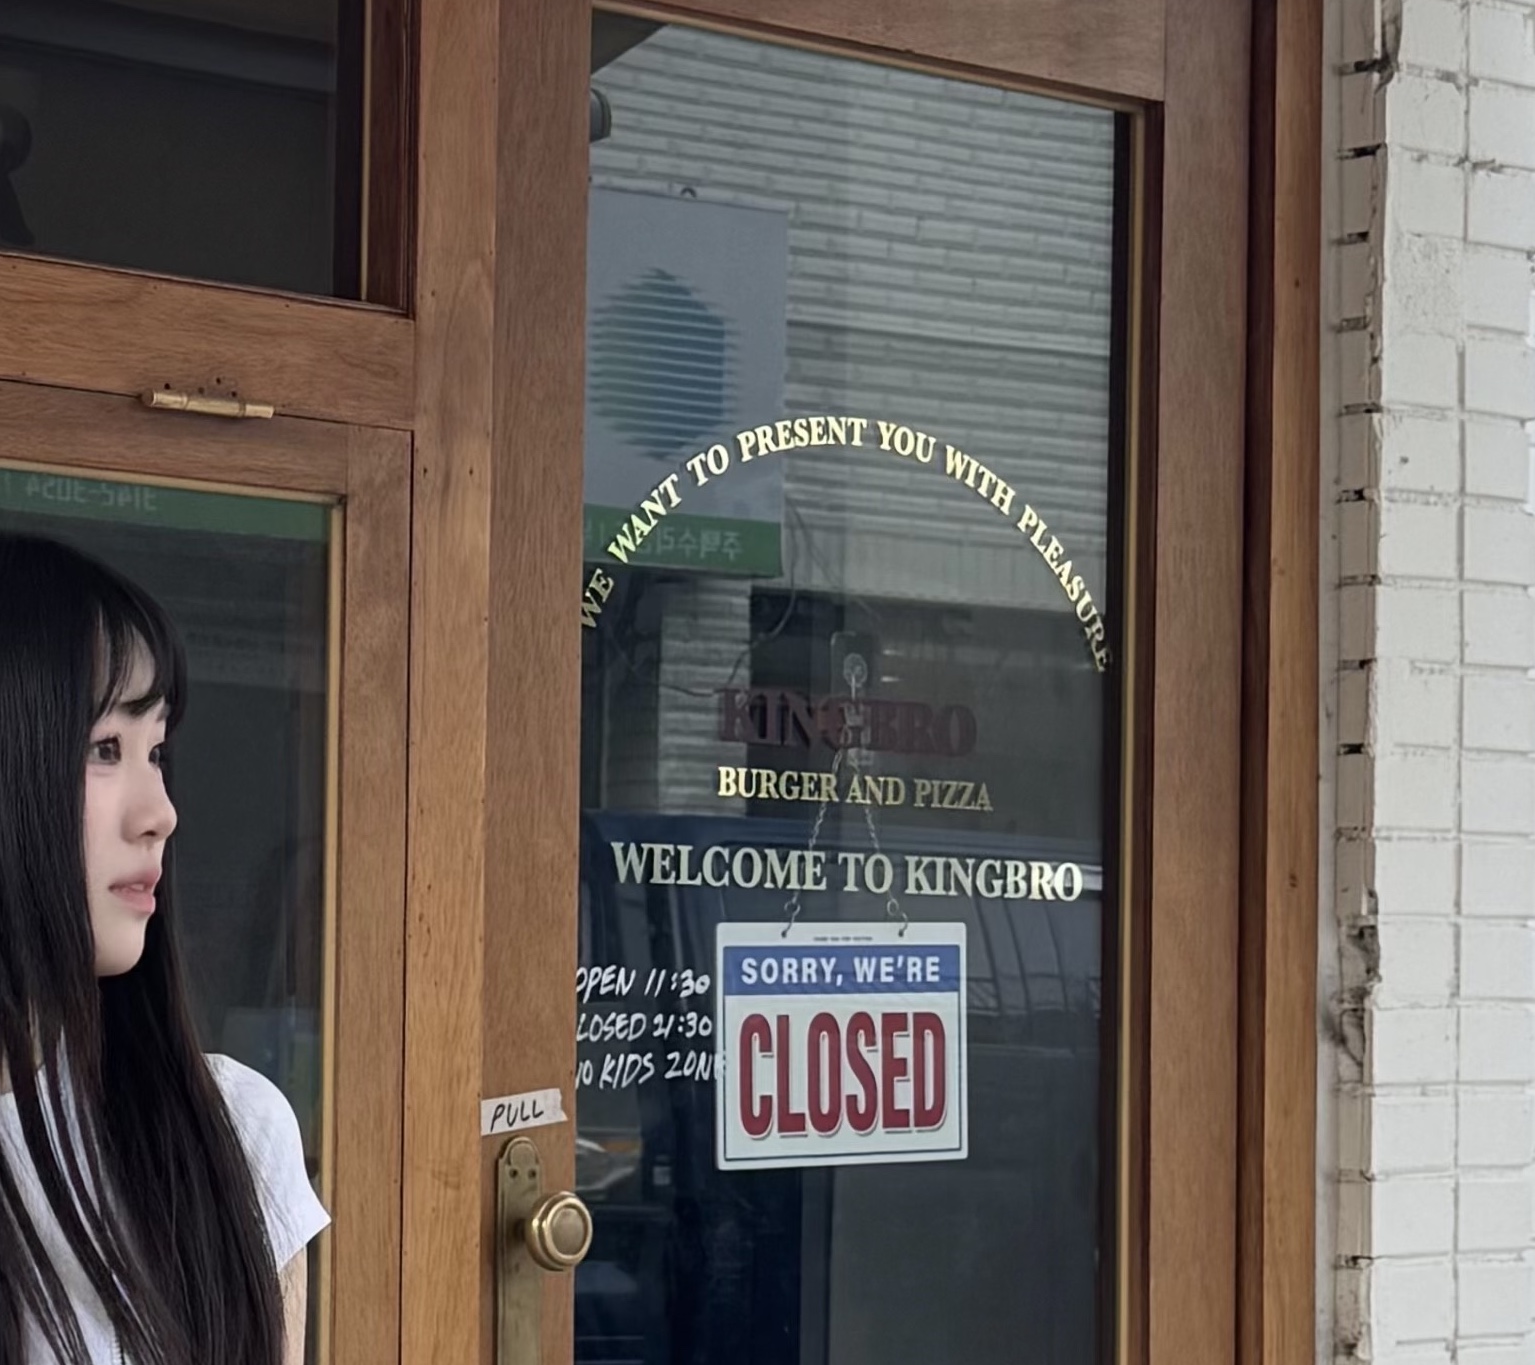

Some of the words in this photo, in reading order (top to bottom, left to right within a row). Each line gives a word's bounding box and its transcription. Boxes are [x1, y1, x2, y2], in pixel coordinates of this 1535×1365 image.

[581, 568, 615, 629] WE
[607, 474, 683, 564] WANT
[686, 444, 730, 487] TO
[736, 416, 868, 462] PRESENT
[877, 420, 936, 463] YOU
[945, 444, 1016, 516] WITH
[1016, 504, 1110, 672] PLEASURE
[716, 687, 978, 758] KINGBRO
[717, 766, 840, 803] BURGER
[846, 774, 906, 807] AND
[913, 777, 994, 813] PIZZA
[610, 841, 827, 892] WELCOME
[837, 851, 894, 895] TO
[904, 855, 1084, 903] KINGBRO
[576, 965, 636, 1004] OPEN
[644, 968, 711, 998] 11:30
[741, 956, 844, 987] SORRY,
[854, 955, 941, 984] WE'RE
[576, 1011, 647, 1042] LOSED
[653, 1011, 713, 1040] 21:30
[599, 1051, 655, 1090] KIDS
[740, 1012, 948, 1138] CLOSED
[490, 1099, 545, 1132] PULL
